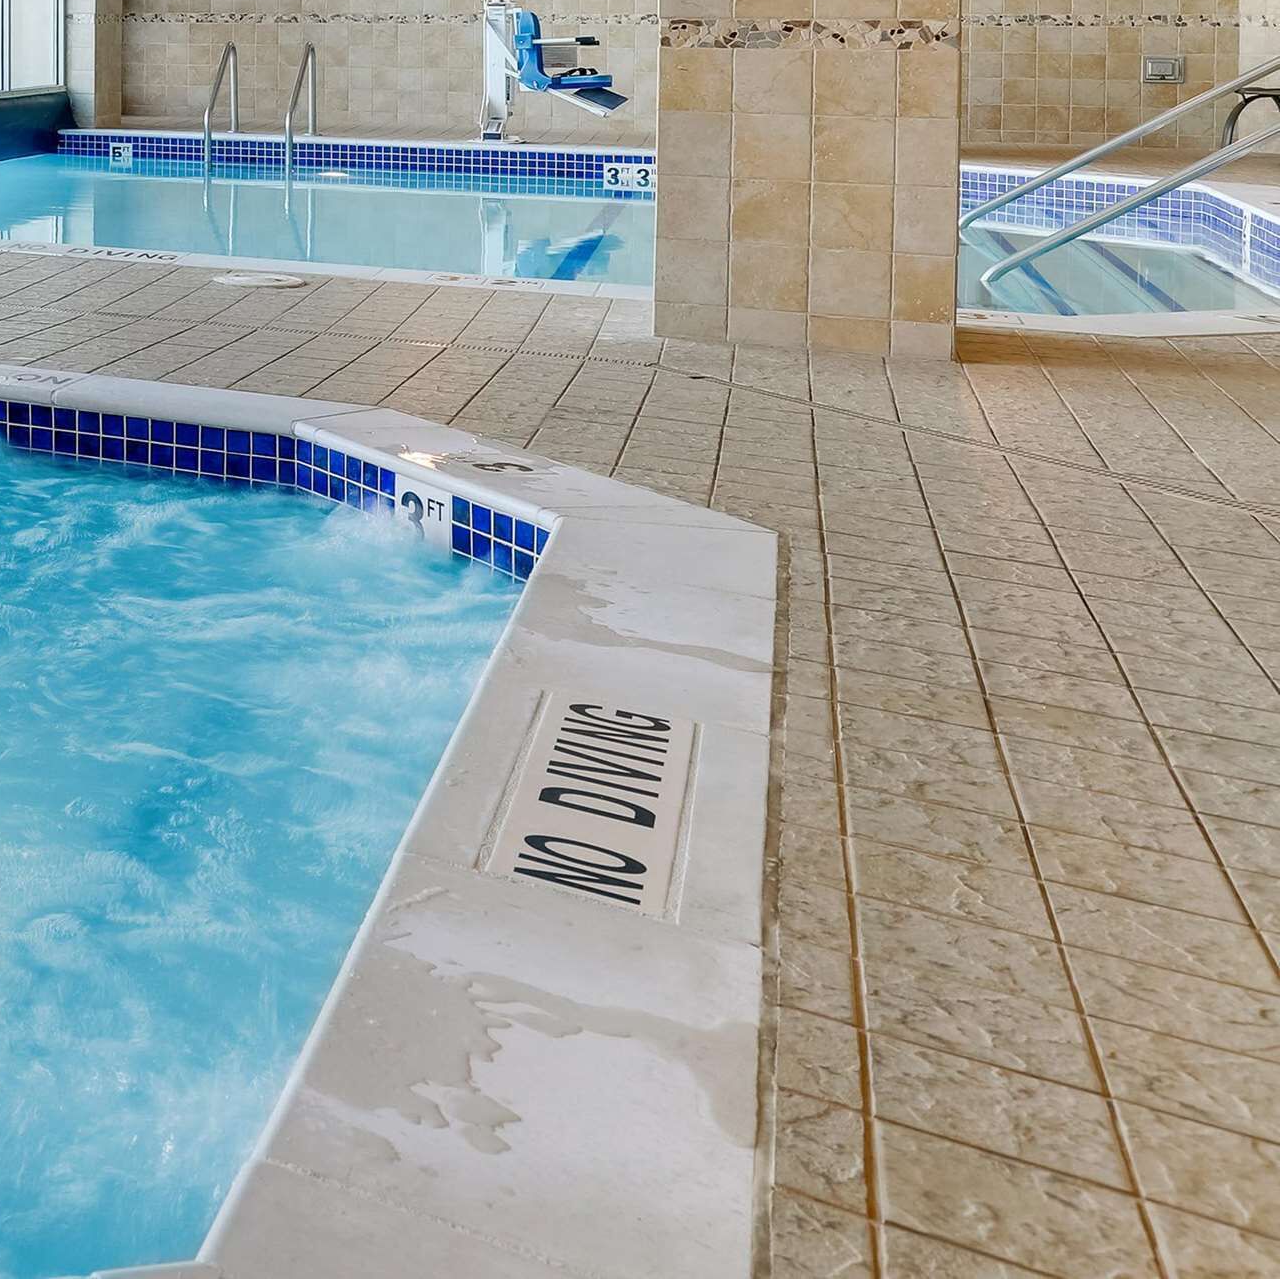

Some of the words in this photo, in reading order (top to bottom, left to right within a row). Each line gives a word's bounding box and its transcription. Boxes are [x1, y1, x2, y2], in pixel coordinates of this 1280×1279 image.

[112, 146, 122, 158] 5
[607, 167, 620, 186] 3
[636, 168, 650, 187] 3
[67, 248, 180, 261] DIVING
[427, 498, 445, 521] FT
[538, 703, 672, 829] DIVING
[513, 834, 647, 905] NO
